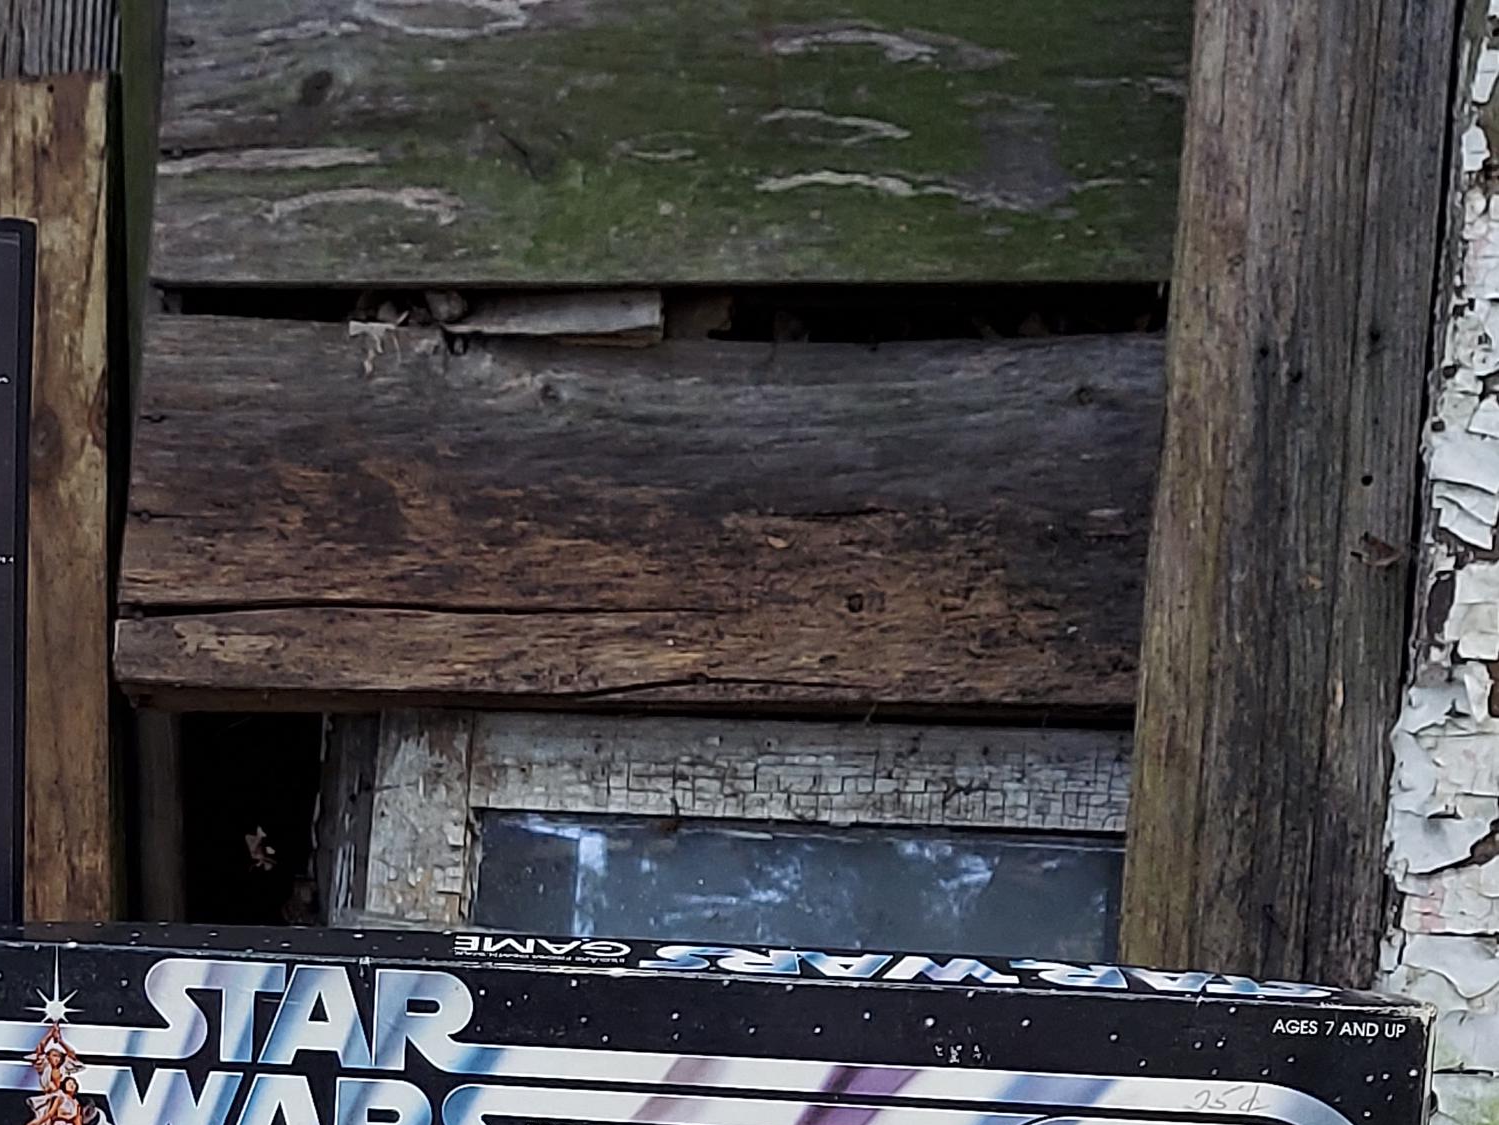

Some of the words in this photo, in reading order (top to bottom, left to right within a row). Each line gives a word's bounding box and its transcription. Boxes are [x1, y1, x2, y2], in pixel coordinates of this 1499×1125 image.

[453, 934, 632, 957] GAME
[639, 943, 1020, 984] WARS
[1008, 958, 1343, 998] STAR
[145, 958, 474, 1072] STAR
[1272, 1019, 1318, 1035] AGES
[1324, 1021, 1335, 1036] 7
[1338, 1022, 1380, 1037] AND
[1384, 1023, 1406, 1038] UP
